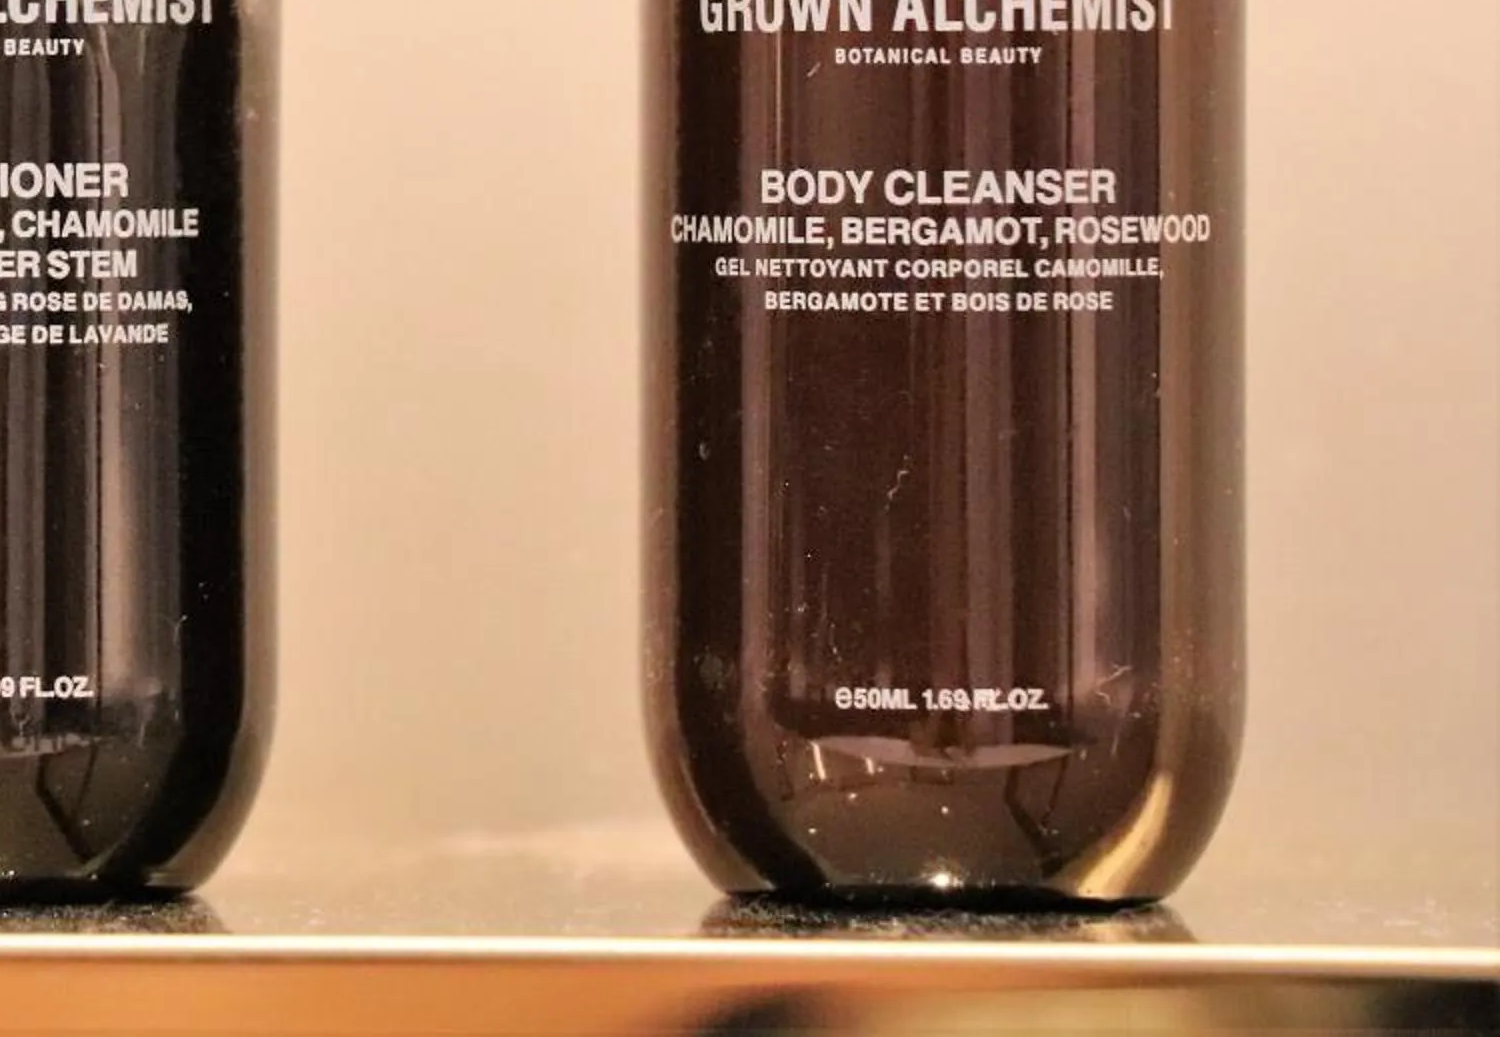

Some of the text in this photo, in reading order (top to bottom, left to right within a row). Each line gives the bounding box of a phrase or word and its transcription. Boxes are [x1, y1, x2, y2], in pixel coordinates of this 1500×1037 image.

[4, 38, 85, 55] BEAUTY
[835, 48, 1043, 64] BOTANICAL BEAUTY
[761, 169, 1117, 206] BODY CLEANSER
[12, 208, 199, 238] CHAMOMILE
[670, 214, 1210, 249] CHAMOMILE, BERGAMOT, ROSEWOOD
[47, 250, 137, 278] STEM
[715, 258, 1164, 279] GEL NETTOYANT CORPOREL CAMOMILLE,
[12, 291, 77, 311] ROSE
[84, 292, 113, 310] DE
[118, 291, 193, 313] DAMAS,
[765, 291, 1113, 311] BERGAMOTE ET BOIS DE ROSE
[32, 325, 63, 343] DE
[70, 324, 169, 343] LAVANDE
[20, 675, 95, 698] FL.OZ.
